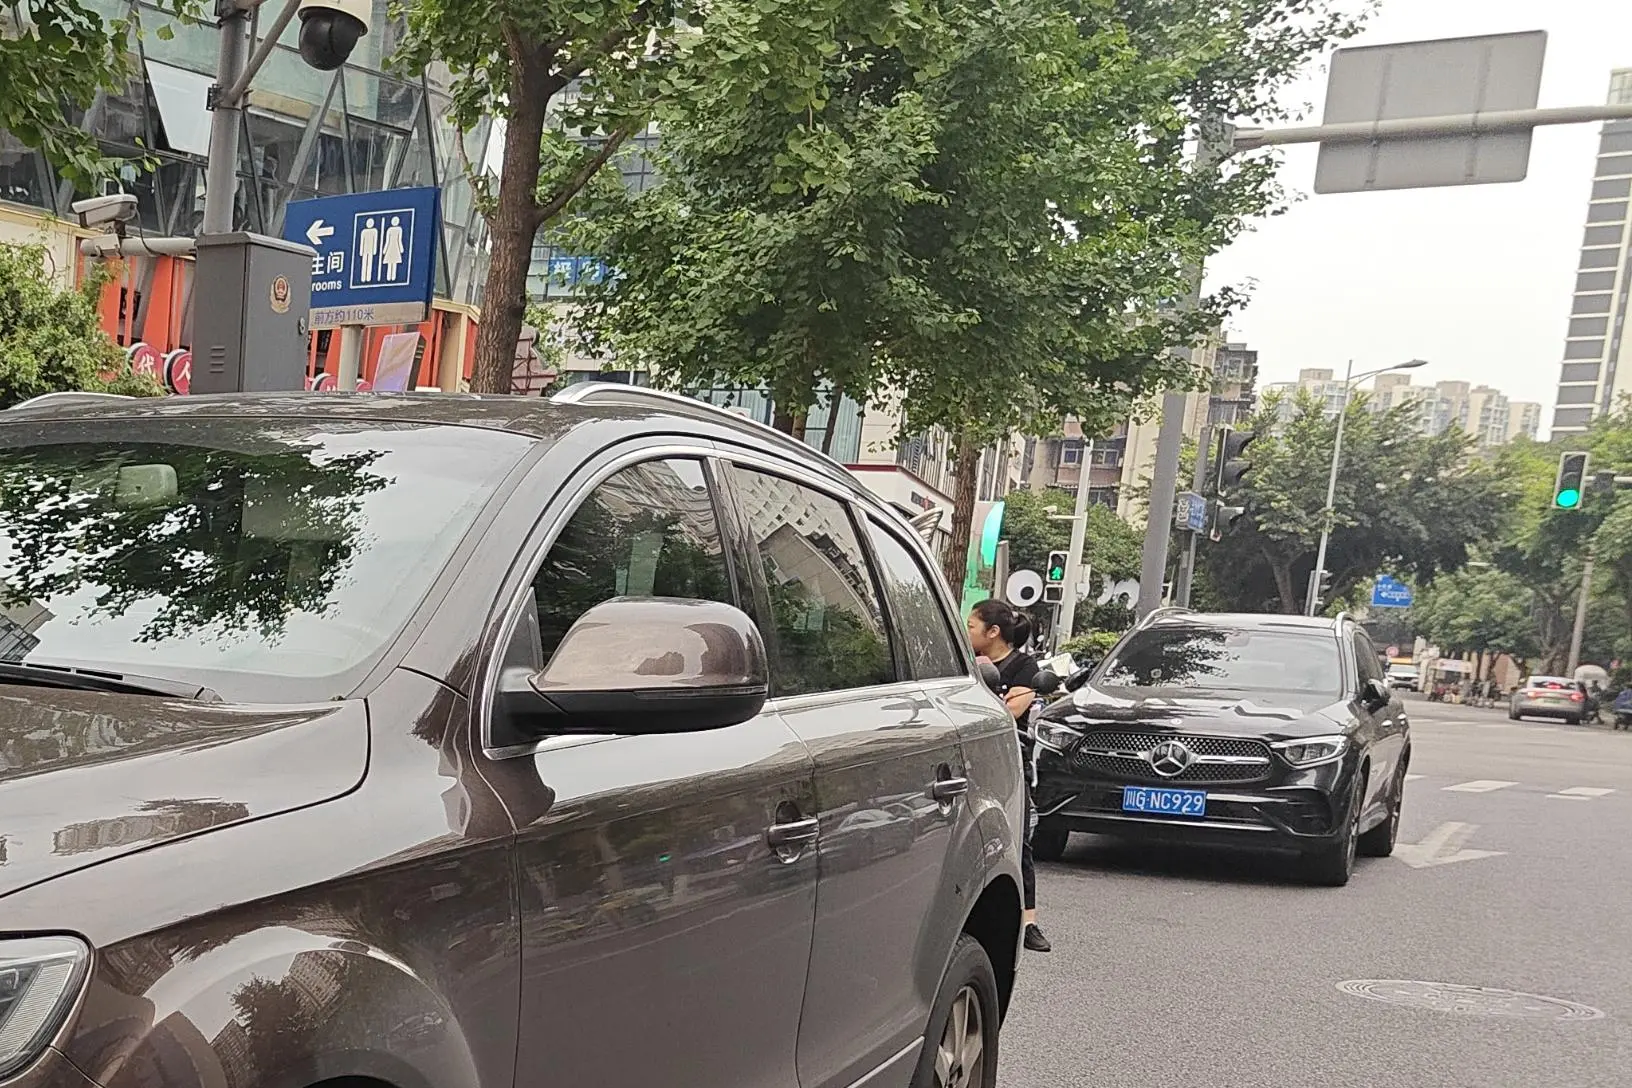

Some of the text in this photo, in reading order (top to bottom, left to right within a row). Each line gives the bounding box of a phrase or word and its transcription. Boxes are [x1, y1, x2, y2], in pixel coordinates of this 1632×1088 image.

[311, 252, 345, 275] 生间
[311, 280, 343, 292] rooms
[314, 308, 375, 325] 前方约110米
